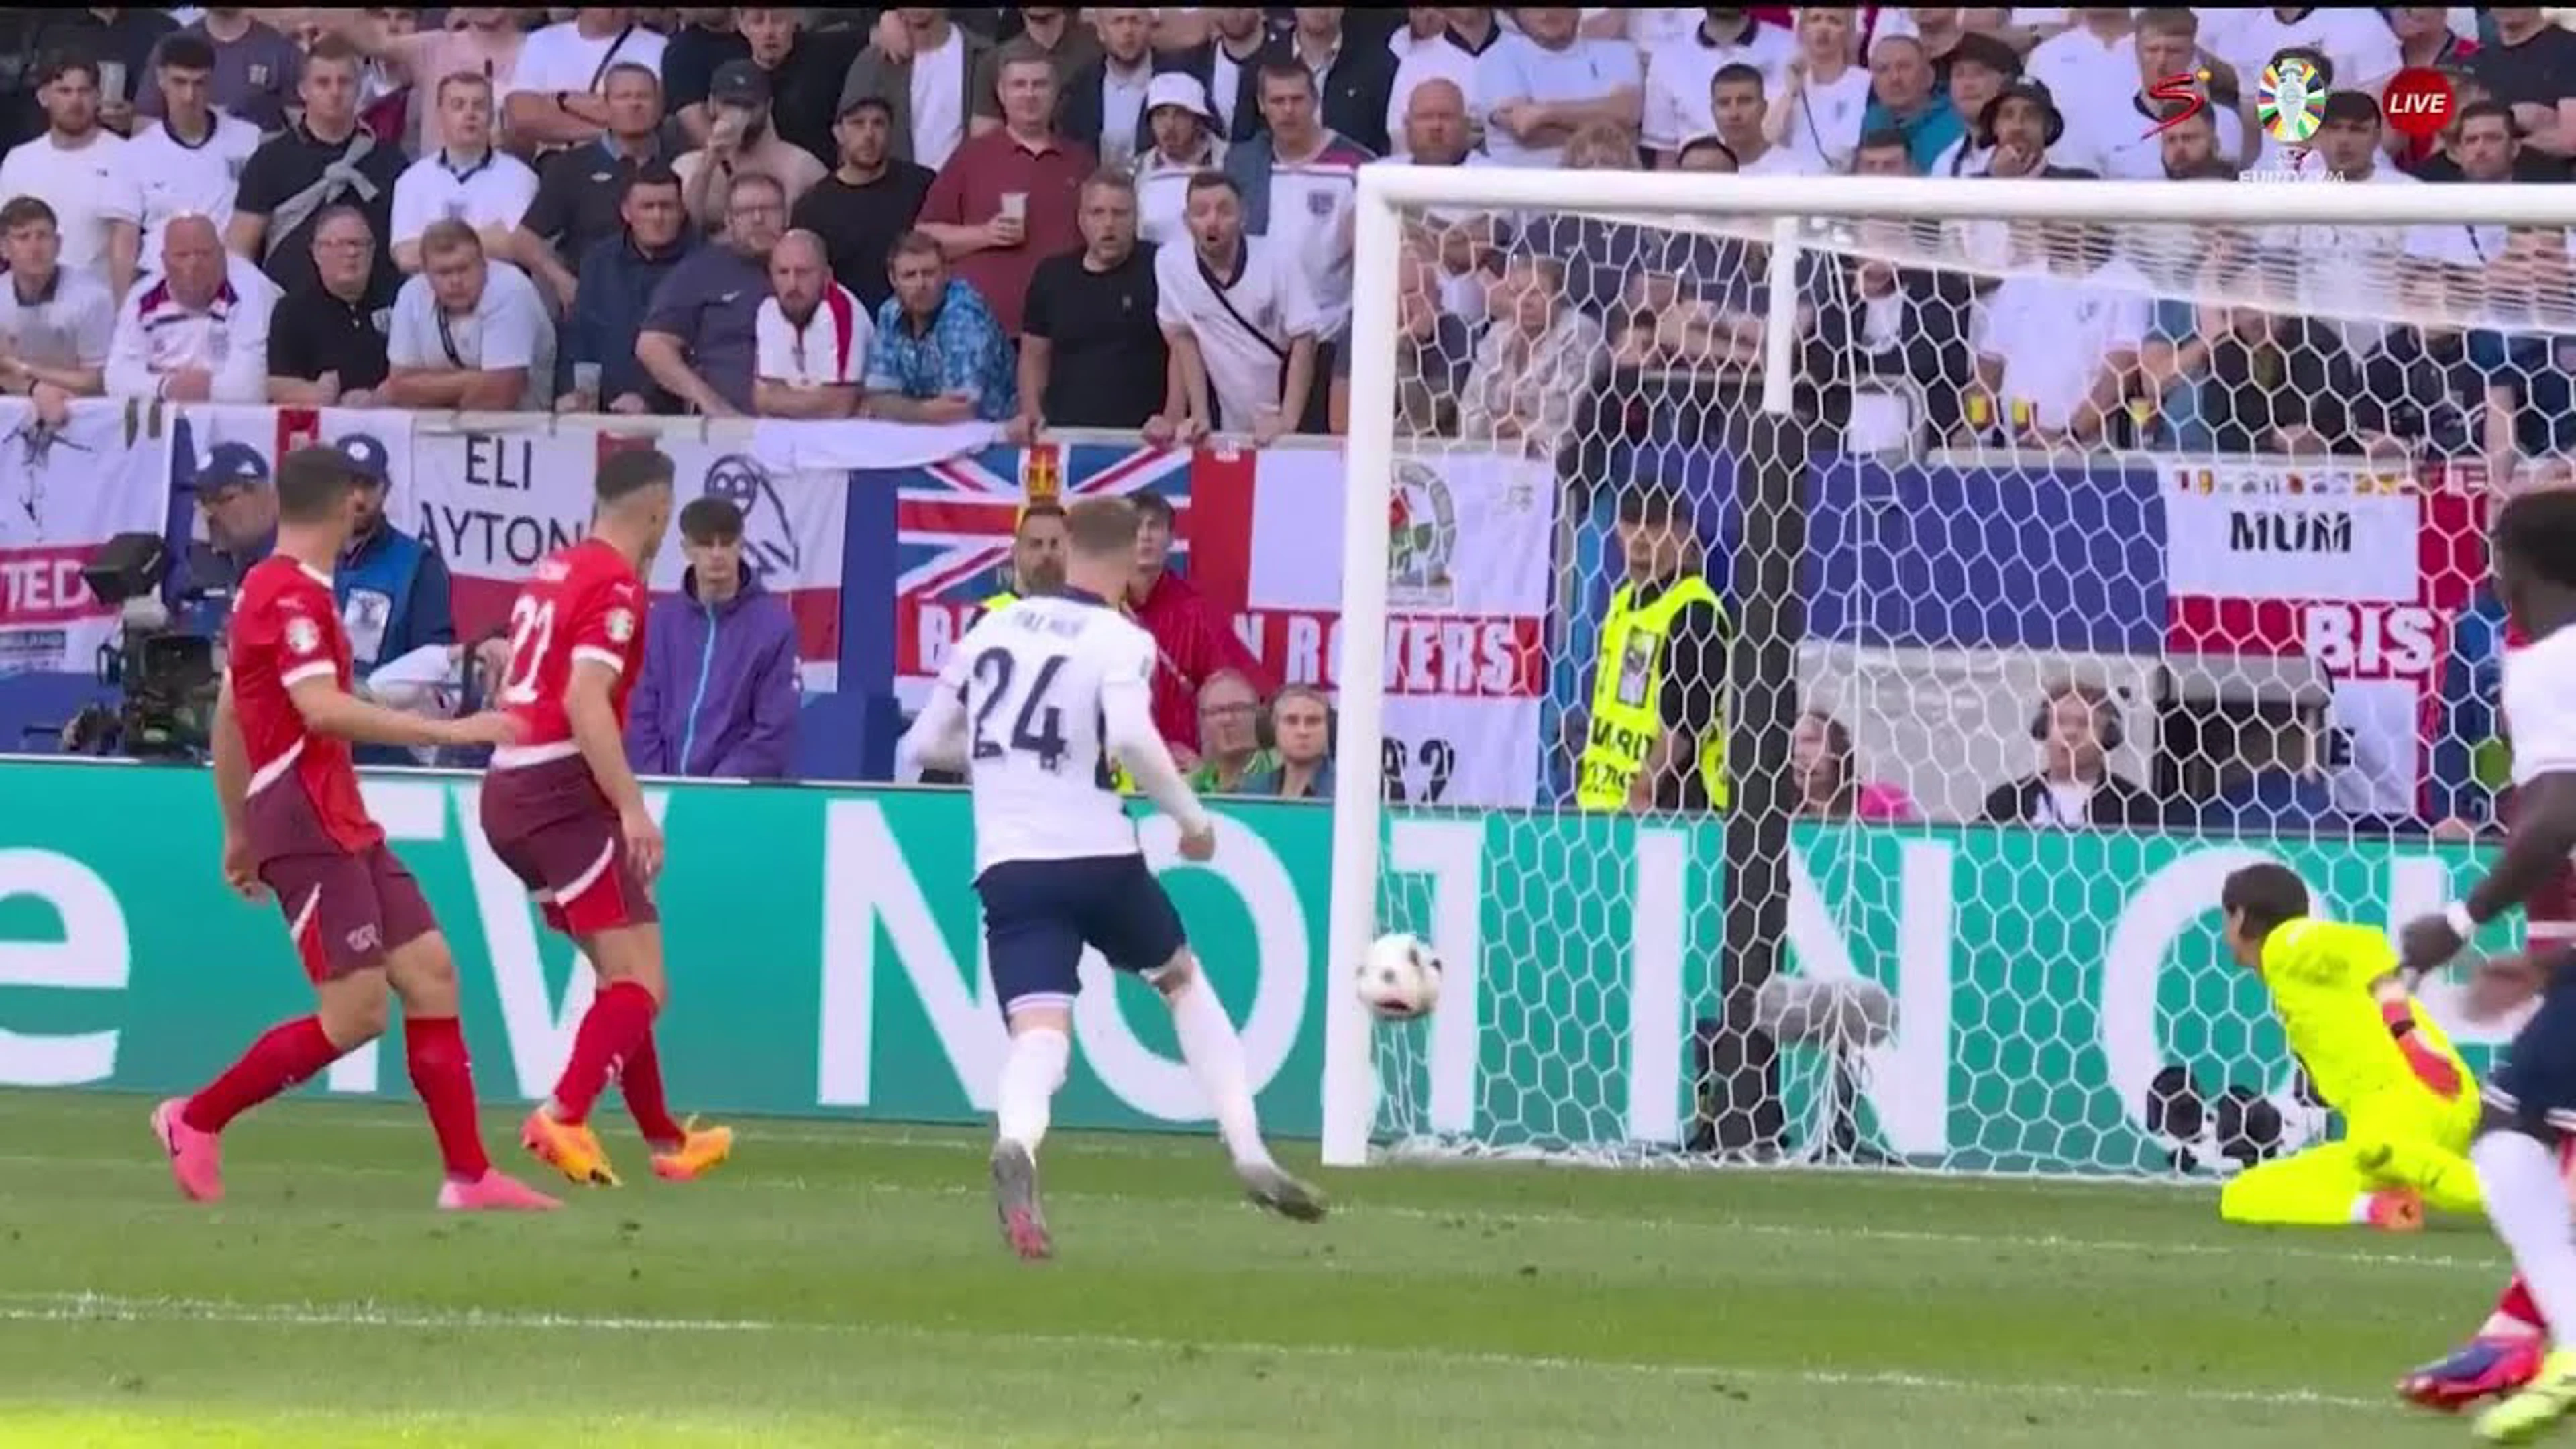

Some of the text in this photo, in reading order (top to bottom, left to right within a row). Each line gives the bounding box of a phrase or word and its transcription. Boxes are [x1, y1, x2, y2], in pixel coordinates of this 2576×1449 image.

[466, 434, 532, 490] ELI
[2231, 510, 2351, 553] MUM
[973, 646, 1073, 771] 24
[817, 798, 1487, 1135] NO1
[1627, 828, 1954, 1155] IN
